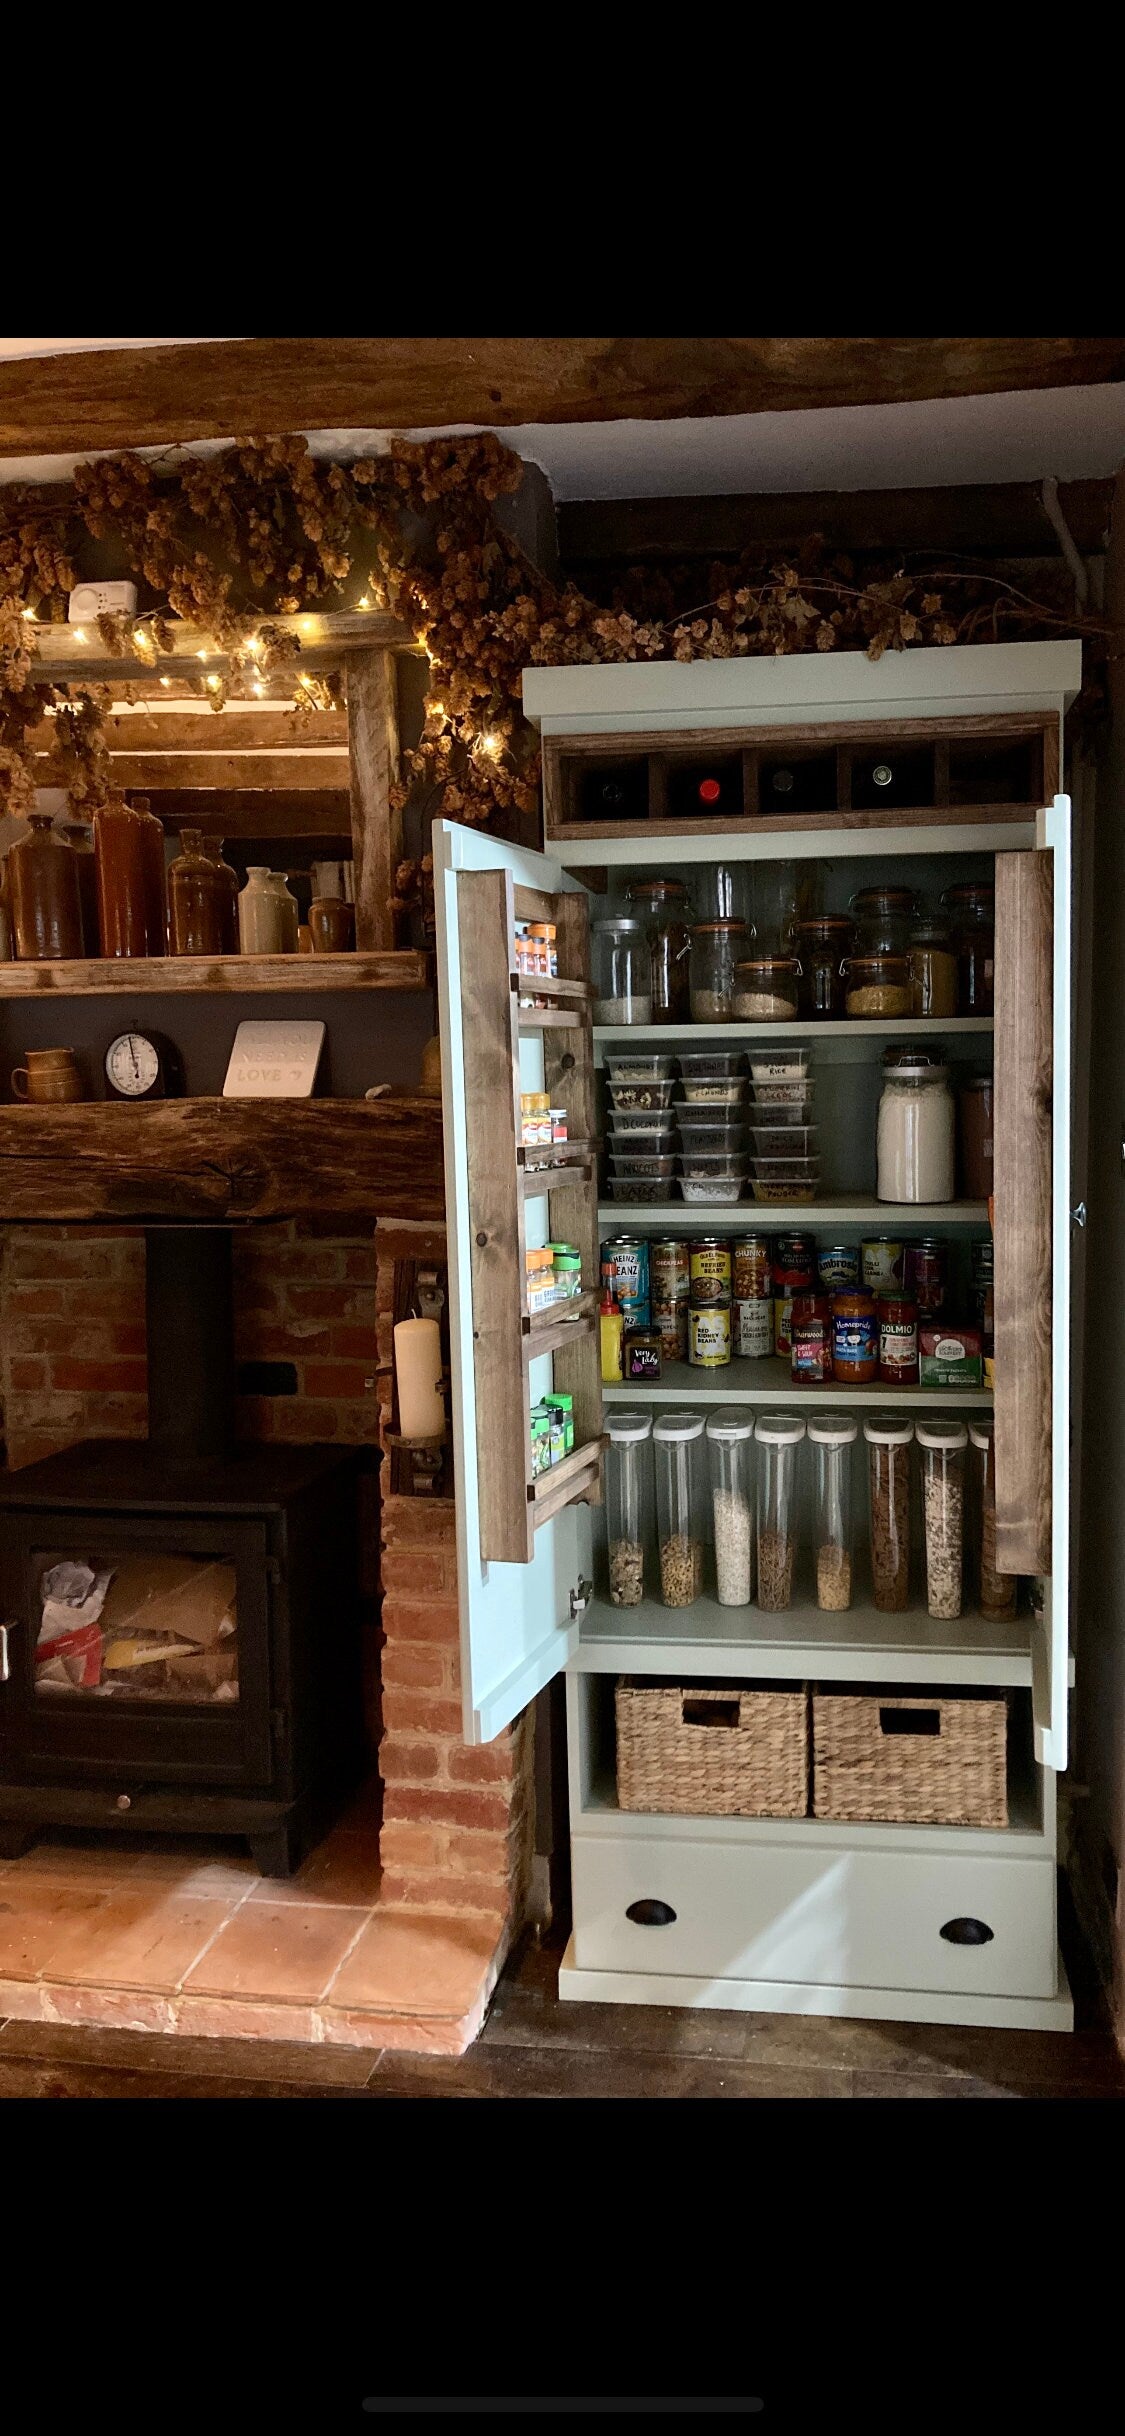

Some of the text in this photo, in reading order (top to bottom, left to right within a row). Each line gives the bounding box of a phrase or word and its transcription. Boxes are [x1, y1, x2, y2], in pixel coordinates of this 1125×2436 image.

[237, 1069, 281, 1082] LOVE
[769, 1067, 787, 1076] RICE
[613, 1255, 635, 1263] HEINZ
[734, 1250, 768, 1258] CHUNKY
[616, 1265, 638, 1276] EANZ
[836, 1320, 871, 1331] Homepride
[881, 1324, 912, 1334] DOLMIO
[634, 1349, 651, 1358] Very
[641, 1353, 660, 1366] Lazy
